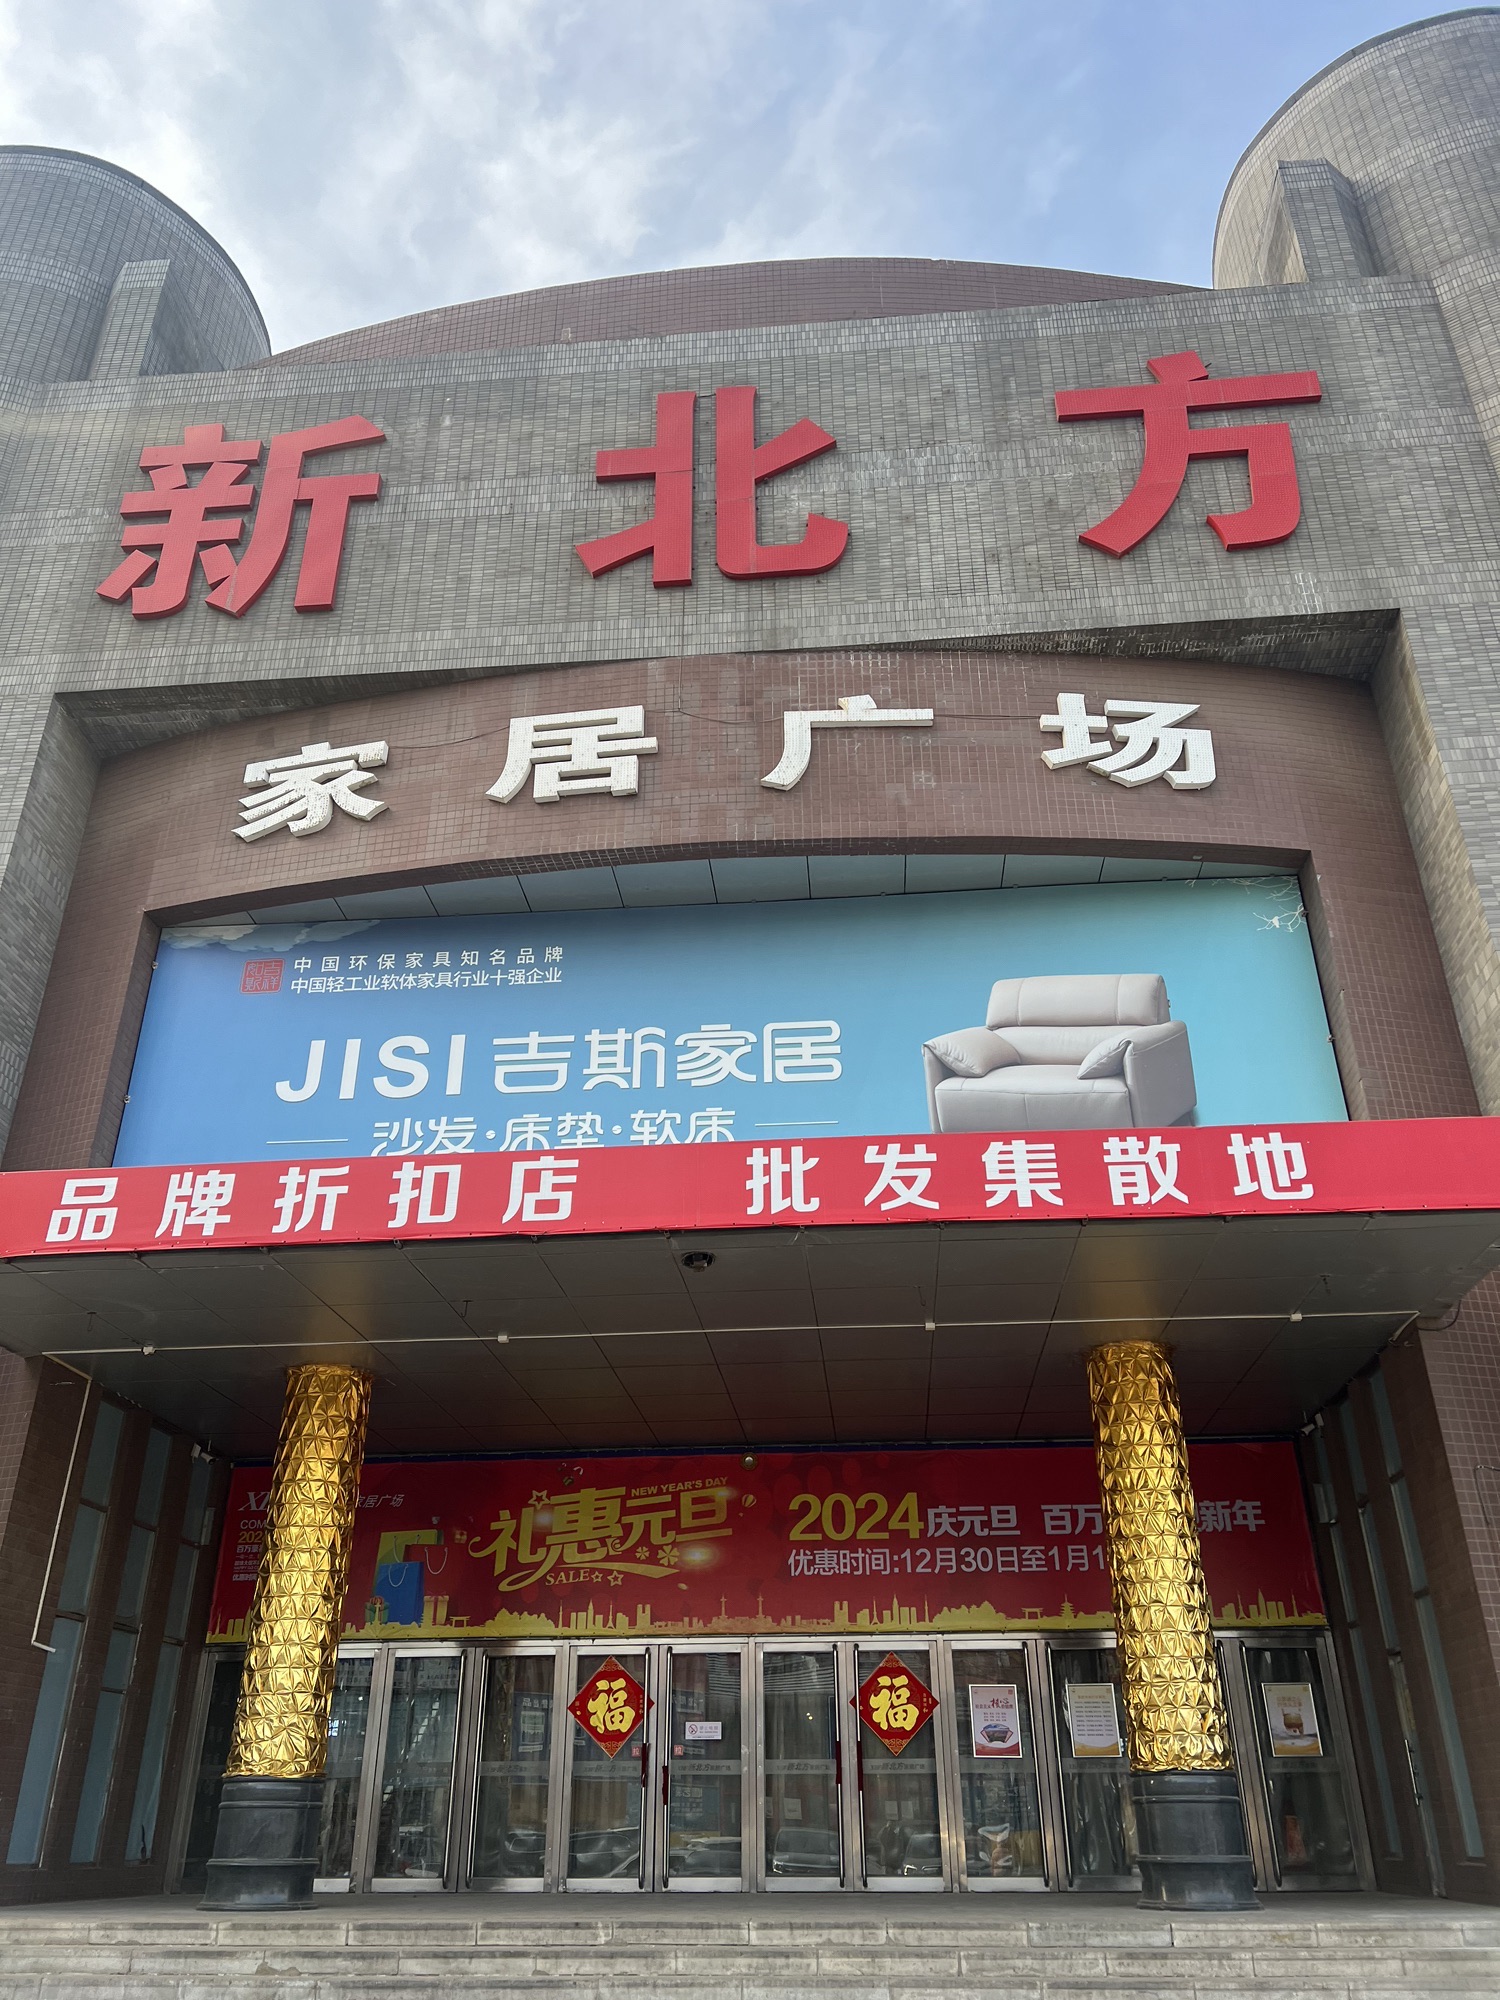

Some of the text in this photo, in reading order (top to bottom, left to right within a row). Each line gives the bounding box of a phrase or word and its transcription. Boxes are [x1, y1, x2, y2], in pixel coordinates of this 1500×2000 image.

[96, 351, 1322, 621] 新北方
[231, 693, 1217, 842] 家居广场
[290, 967, 563, 995] 中国轻工业软体家具行业十强企业
[293, 946, 564, 974] 中国环保家具知名品牌
[275, 1020, 843, 1103] JISI 吉斯家居
[45, 1131, 1315, 1243] 品牌折扣店 批发集散地
[631, 1477, 728, 1497] NEW YEAR'S DAY
[1195, 1499, 1266, 1532] 新年
[470, 1486, 733, 1592] 礼惠元旦
[545, 1569, 590, 1586] SALE
[587, 1677, 636, 1735] 福
[869, 1675, 919, 1731] 福
